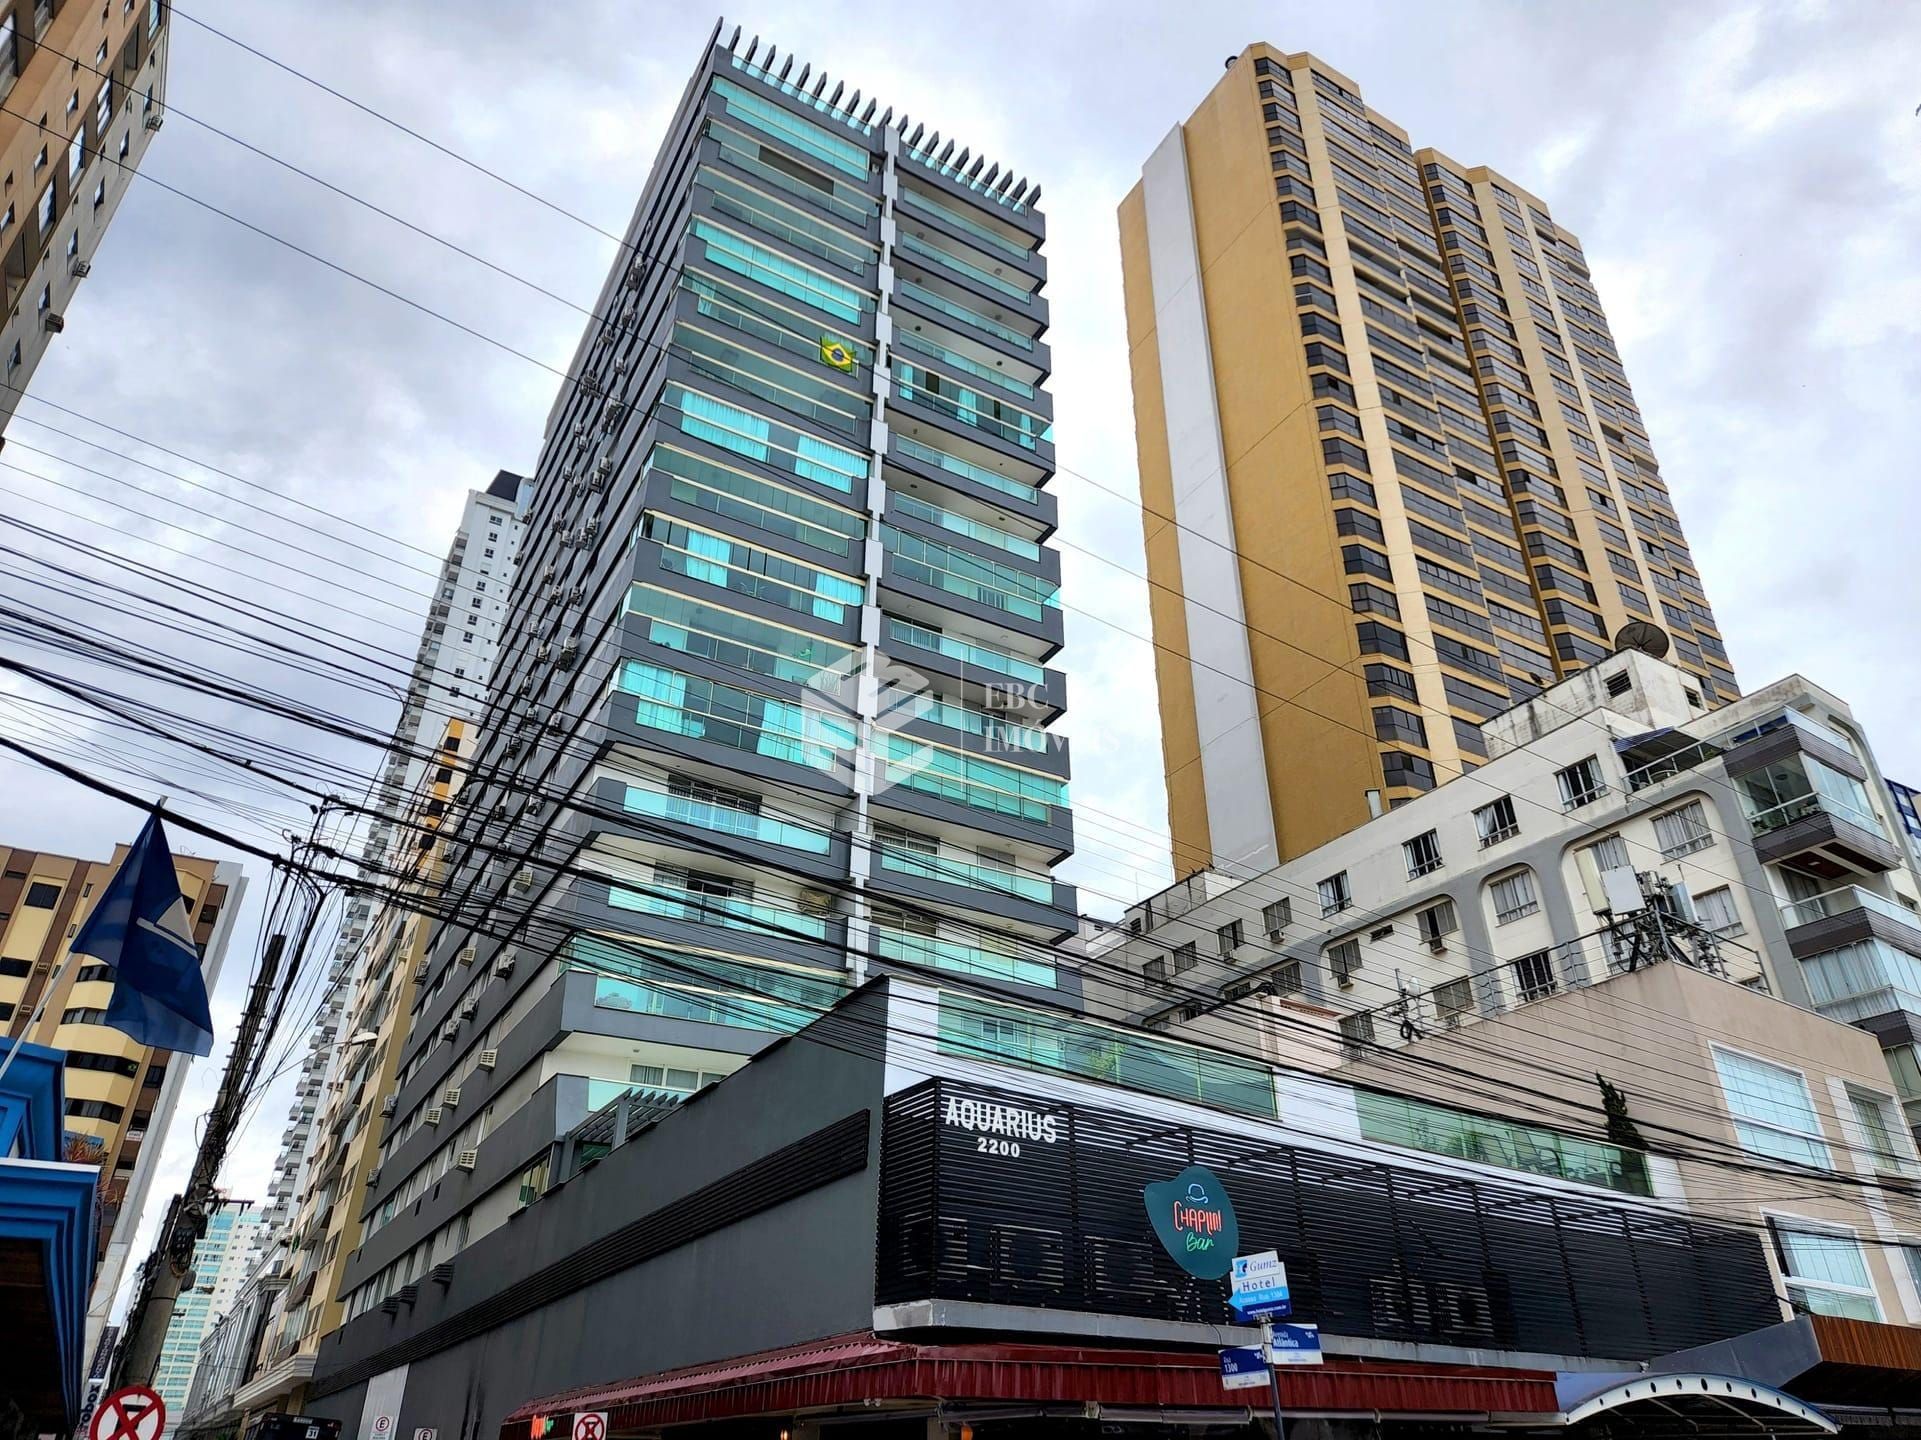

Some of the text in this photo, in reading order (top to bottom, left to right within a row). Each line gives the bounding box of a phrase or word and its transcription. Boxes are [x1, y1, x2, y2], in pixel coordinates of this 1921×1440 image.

[945, 1097, 1057, 1143] AQUARIUS
[977, 1137, 1020, 1157] 2200
[1186, 1231, 1214, 1252] Bar
[1250, 1259, 1277, 1271] Gumz
[1242, 1276, 1275, 1291] Hotel
[1225, 1362, 1238, 1373] 1300
